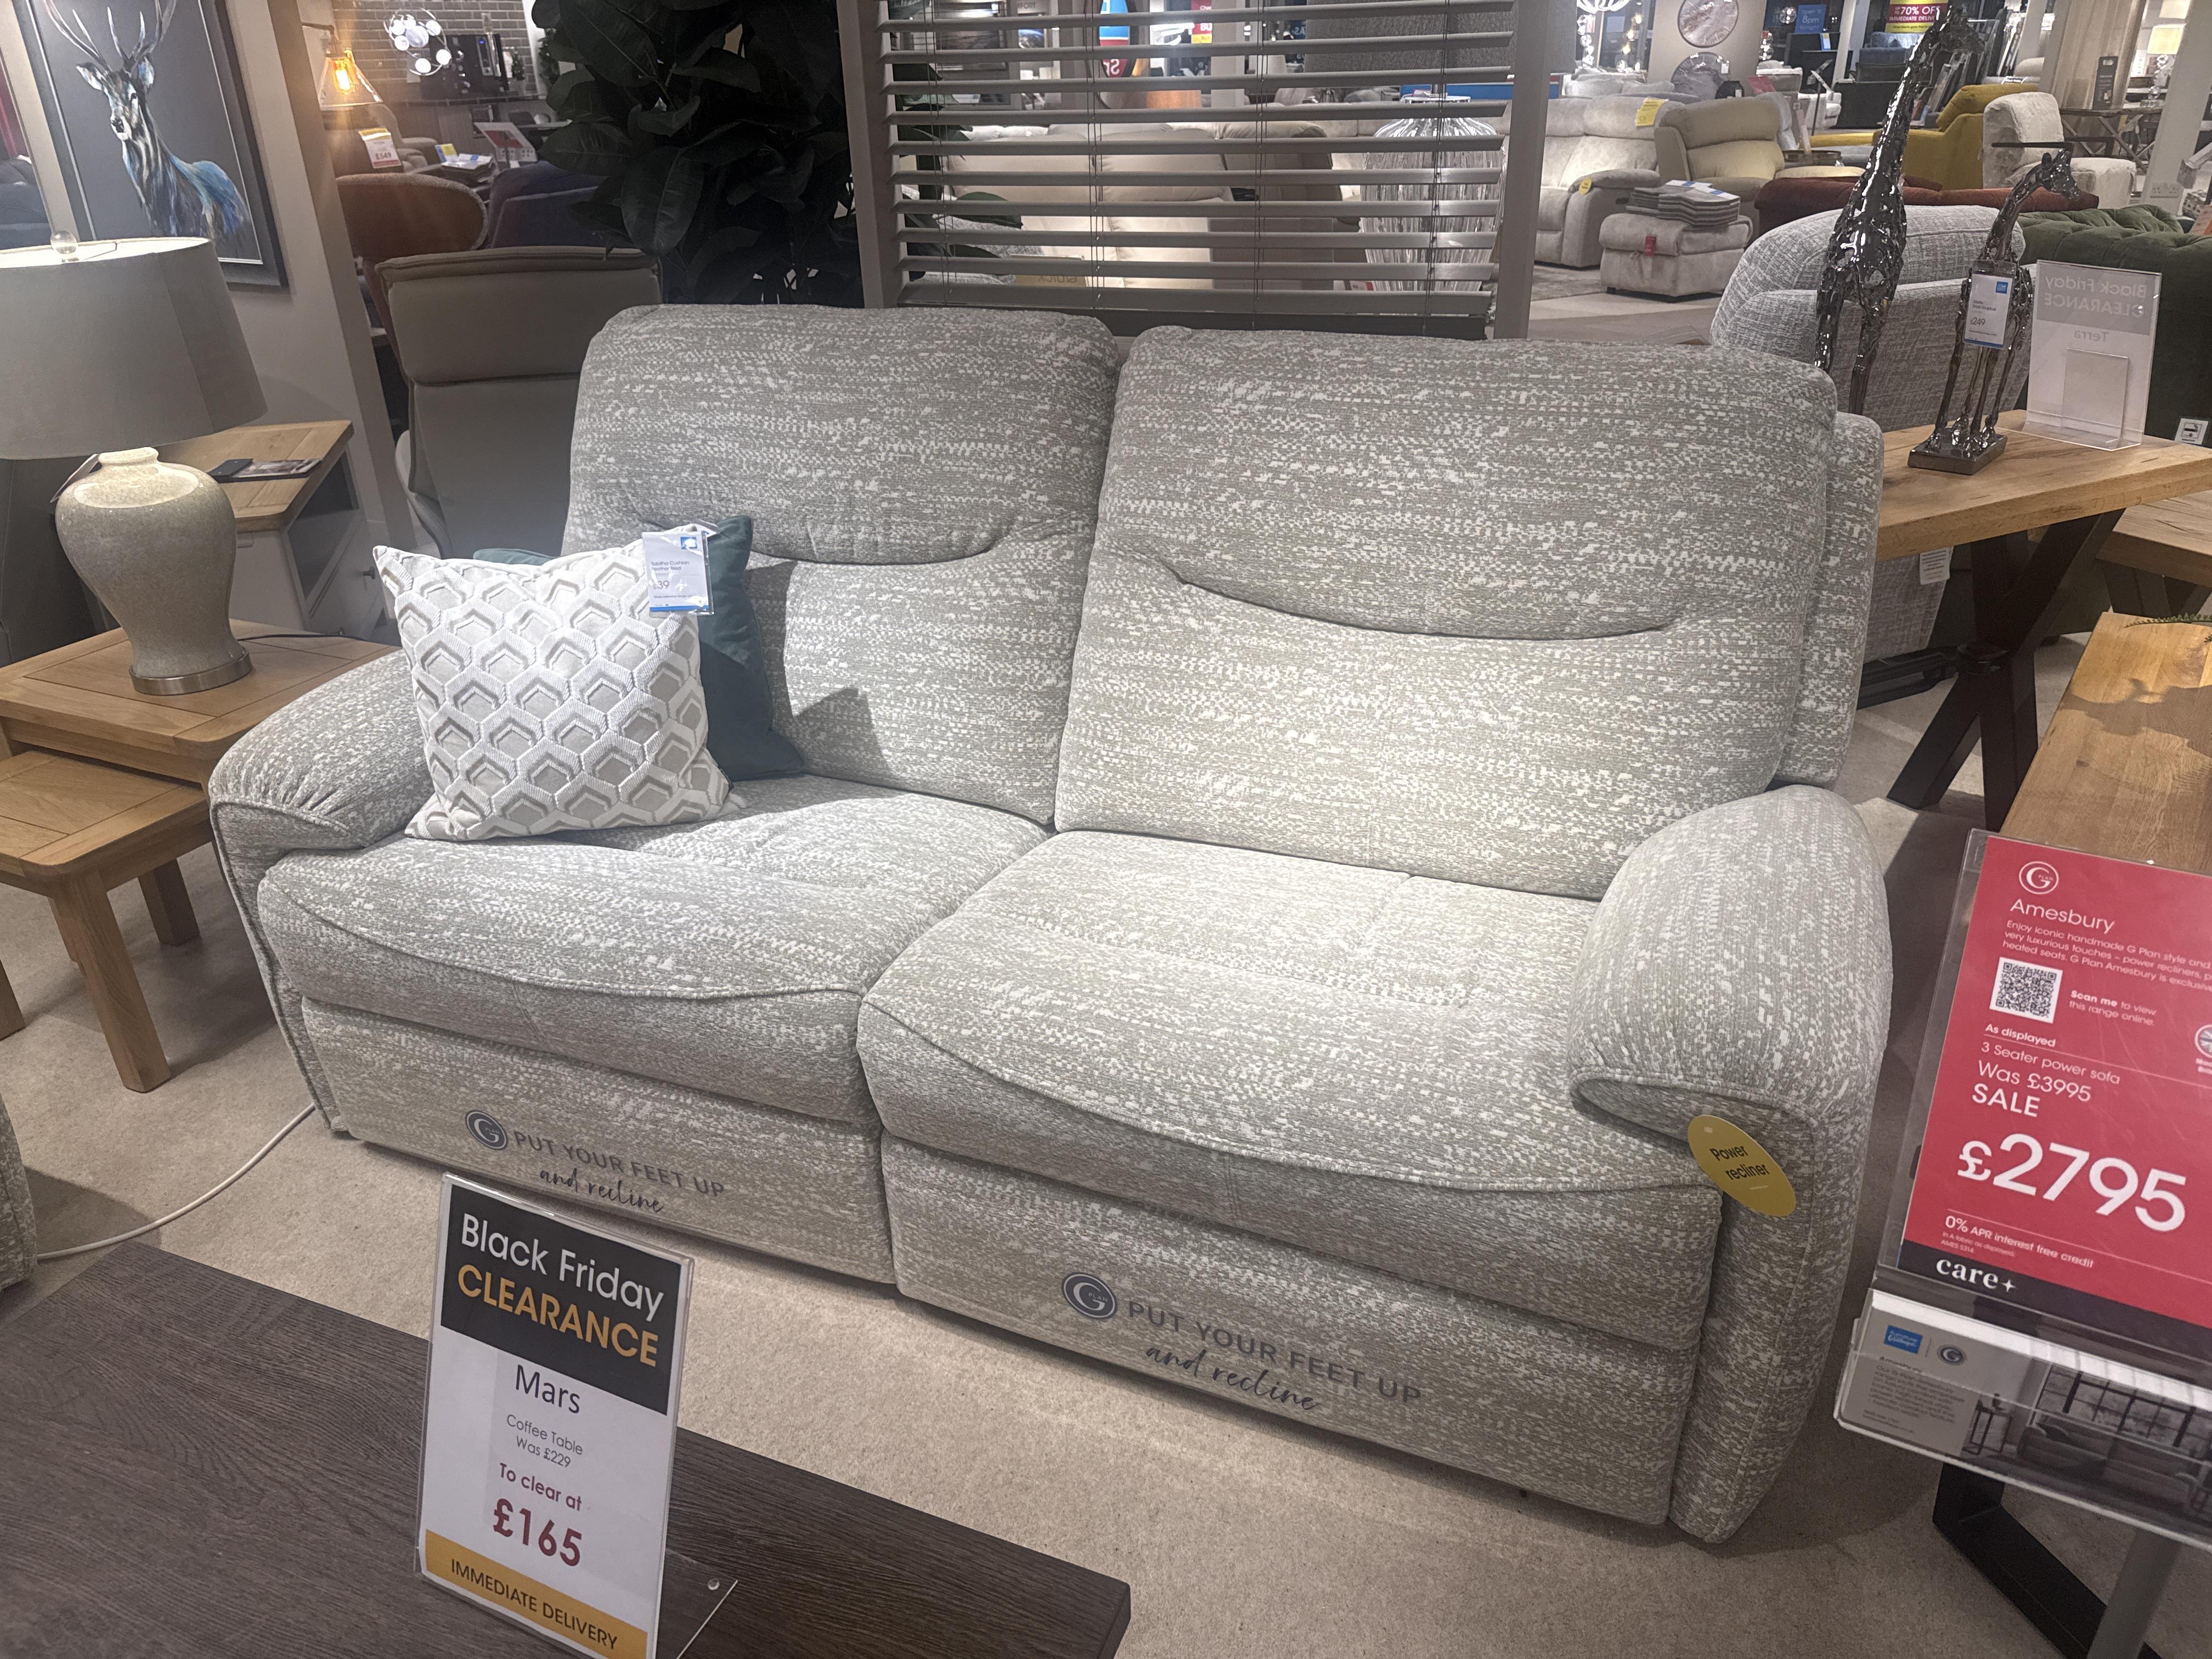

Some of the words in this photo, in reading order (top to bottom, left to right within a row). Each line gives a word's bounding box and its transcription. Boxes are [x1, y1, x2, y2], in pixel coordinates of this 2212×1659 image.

[1970, 317, 1985, 325] £249
[2010, 899, 2114, 934] Amesbury
[2002, 940, 2038, 955] heated
[2070, 955, 2079, 963] G
[2081, 957, 2103, 969] Plan
[2105, 963, 2156, 981] Amesbury
[2005, 932, 2024, 943] very
[2027, 932, 2069, 951] luxurious
[2072, 945, 2112, 960] touches
[2123, 957, 2155, 969] power
[2007, 920, 2033, 933] Enjoy
[2035, 926, 2065, 939] iconic
[2067, 933, 2124, 952] handmade
[2126, 945, 2136, 953] G
[2139, 947, 2161, 959] Plan
[2163, 952, 2186, 965] style
[2188, 958, 2211, 970] and
[2069, 1001, 2086, 1012] this
[2088, 1006, 2119, 1018] range
[2070, 990, 2097, 1003] Scan
[2100, 996, 2118, 1007] me
[2120, 1001, 2130, 1011] to
[2134, 1005, 2157, 1015] view
[1985, 1024, 1999, 1034] As
[2001, 1026, 2056, 1047] displayed
[1978, 1060, 2020, 1085] Was
[2027, 1073, 2091, 1102] £3995
[1981, 1042, 1990, 1053] 3
[1994, 1045, 2038, 1064] Seater
[2041, 1058, 2086, 1076] power
[2090, 1069, 2121, 1085] sofa
[1972, 1082, 2040, 1118] SALE
[513, 1131, 554, 1153] PUT
[562, 1144, 624, 1173] YOUR
[630, 1161, 684, 1188] FEET
[693, 1177, 725, 1198] UP
[1709, 1146, 1748, 1161] Power
[1725, 1164, 1770, 1180] recliner
[540, 1167, 579, 1193] and
[588, 1180, 665, 1214] recline
[1957, 1133, 2187, 1232] £2795
[1945, 1215, 1968, 1232] 0%
[1970, 1227, 1993, 1240] APR
[1994, 1232, 2034, 1251] interest
[2036, 1245, 2058, 1258] free
[2061, 1253, 2094, 1268] credit
[461, 1212, 549, 1276] Black
[558, 1249, 664, 1322] Friday
[458, 1264, 659, 1368] CLEARANCE
[1128, 1300, 1182, 1333] PUT
[1196, 1321, 1278, 1364] YOUR
[1290, 1351, 1366, 1389] FEET
[1378, 1376, 1422, 1403] UP
[516, 1364, 581, 1414] Mars
[1146, 1345, 1207, 1378] and
[1212, 1369, 1319, 1412] recline
[506, 1414, 548, 1441] Coffee
[551, 1431, 584, 1455] Table
[516, 1435, 541, 1457] Was
[543, 1448, 572, 1468] £229
[500, 1462, 517, 1482] To
[521, 1474, 562, 1503] clear
[565, 1493, 583, 1511] at
[493, 1498, 583, 1567] £165
[451, 1559, 538, 1613] IMMEDIATE
[542, 1602, 618, 1650] DELIVERY
